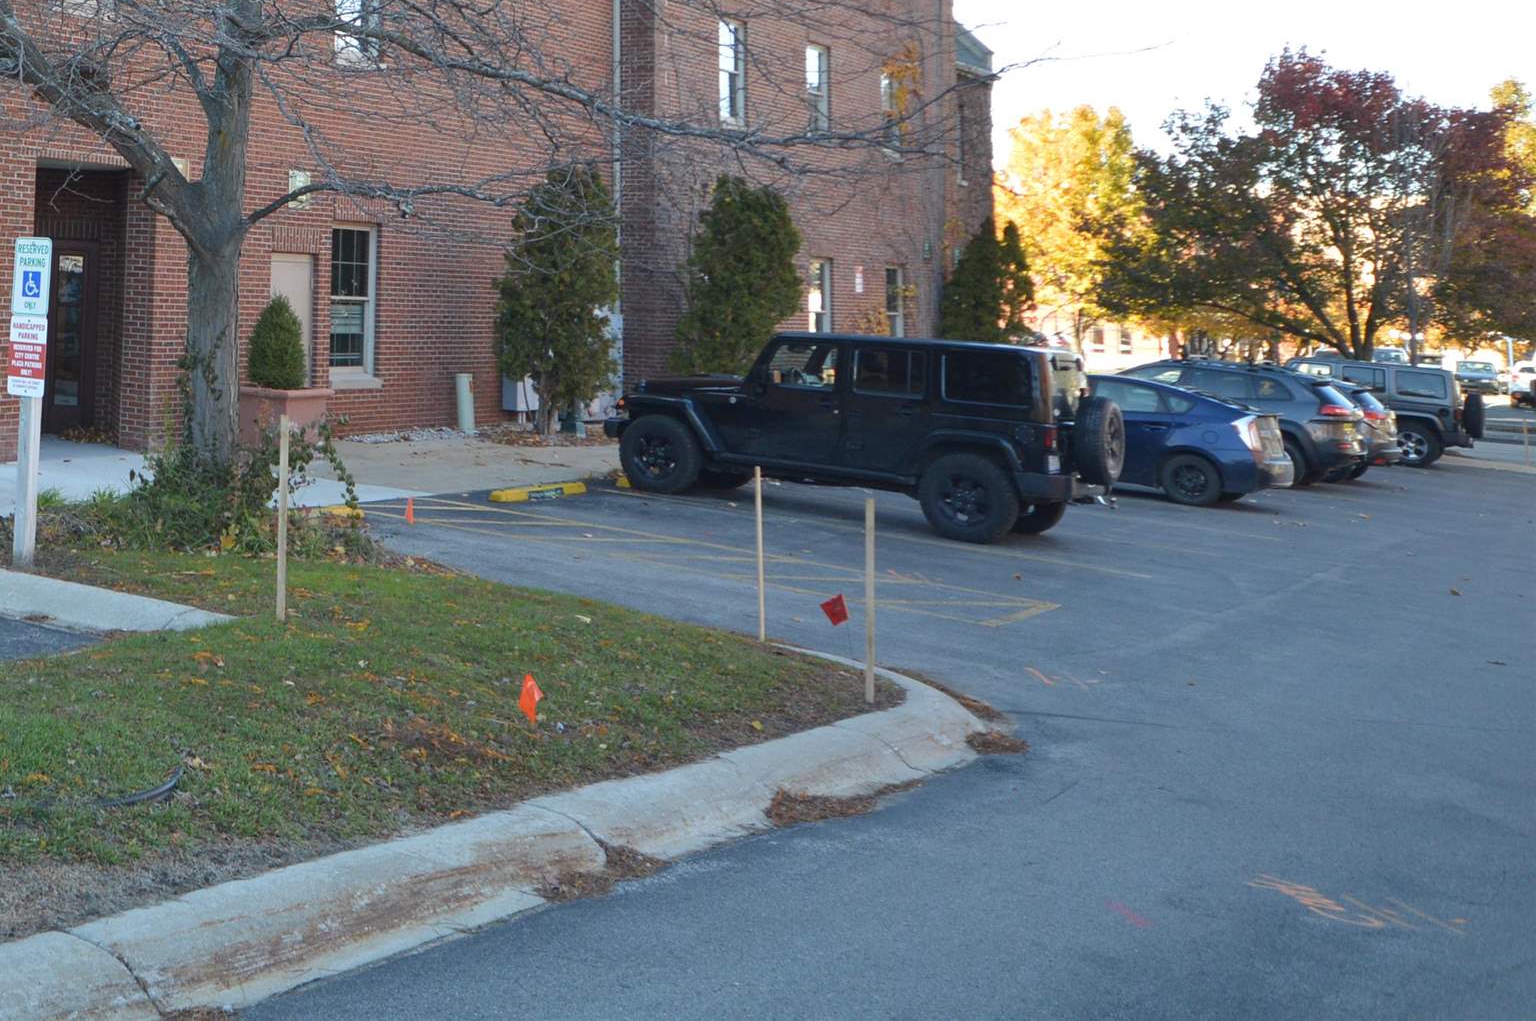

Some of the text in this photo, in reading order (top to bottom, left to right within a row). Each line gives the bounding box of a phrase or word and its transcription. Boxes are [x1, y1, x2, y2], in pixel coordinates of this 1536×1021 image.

[18, 243, 49, 255] RESERVED
[20, 257, 46, 268] PARKING
[13, 322, 46, 332] HANDICAPPED
[18, 332, 39, 341] PARKING
